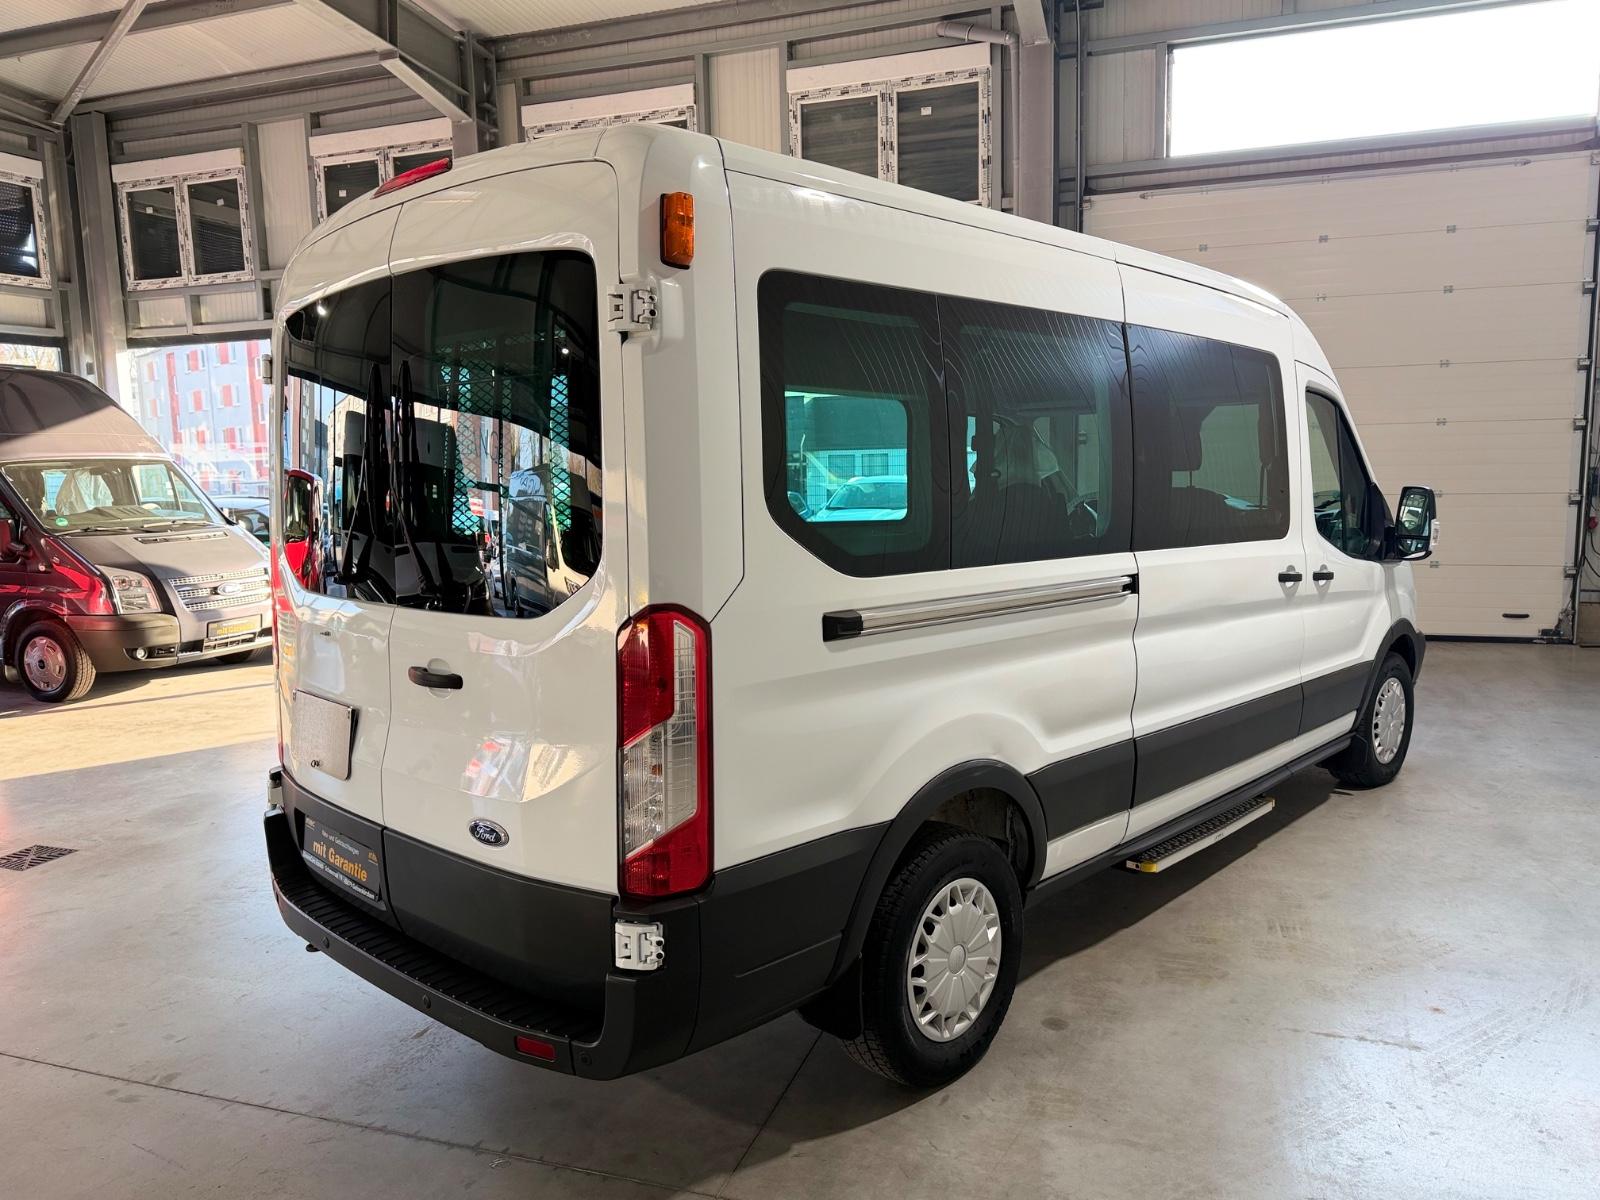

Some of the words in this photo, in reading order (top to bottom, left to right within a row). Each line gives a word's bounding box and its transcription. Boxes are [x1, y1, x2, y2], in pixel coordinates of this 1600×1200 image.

[475, 823, 497, 842] Ford
[312, 841, 326, 858] mit
[328, 847, 368, 882] Garantie
